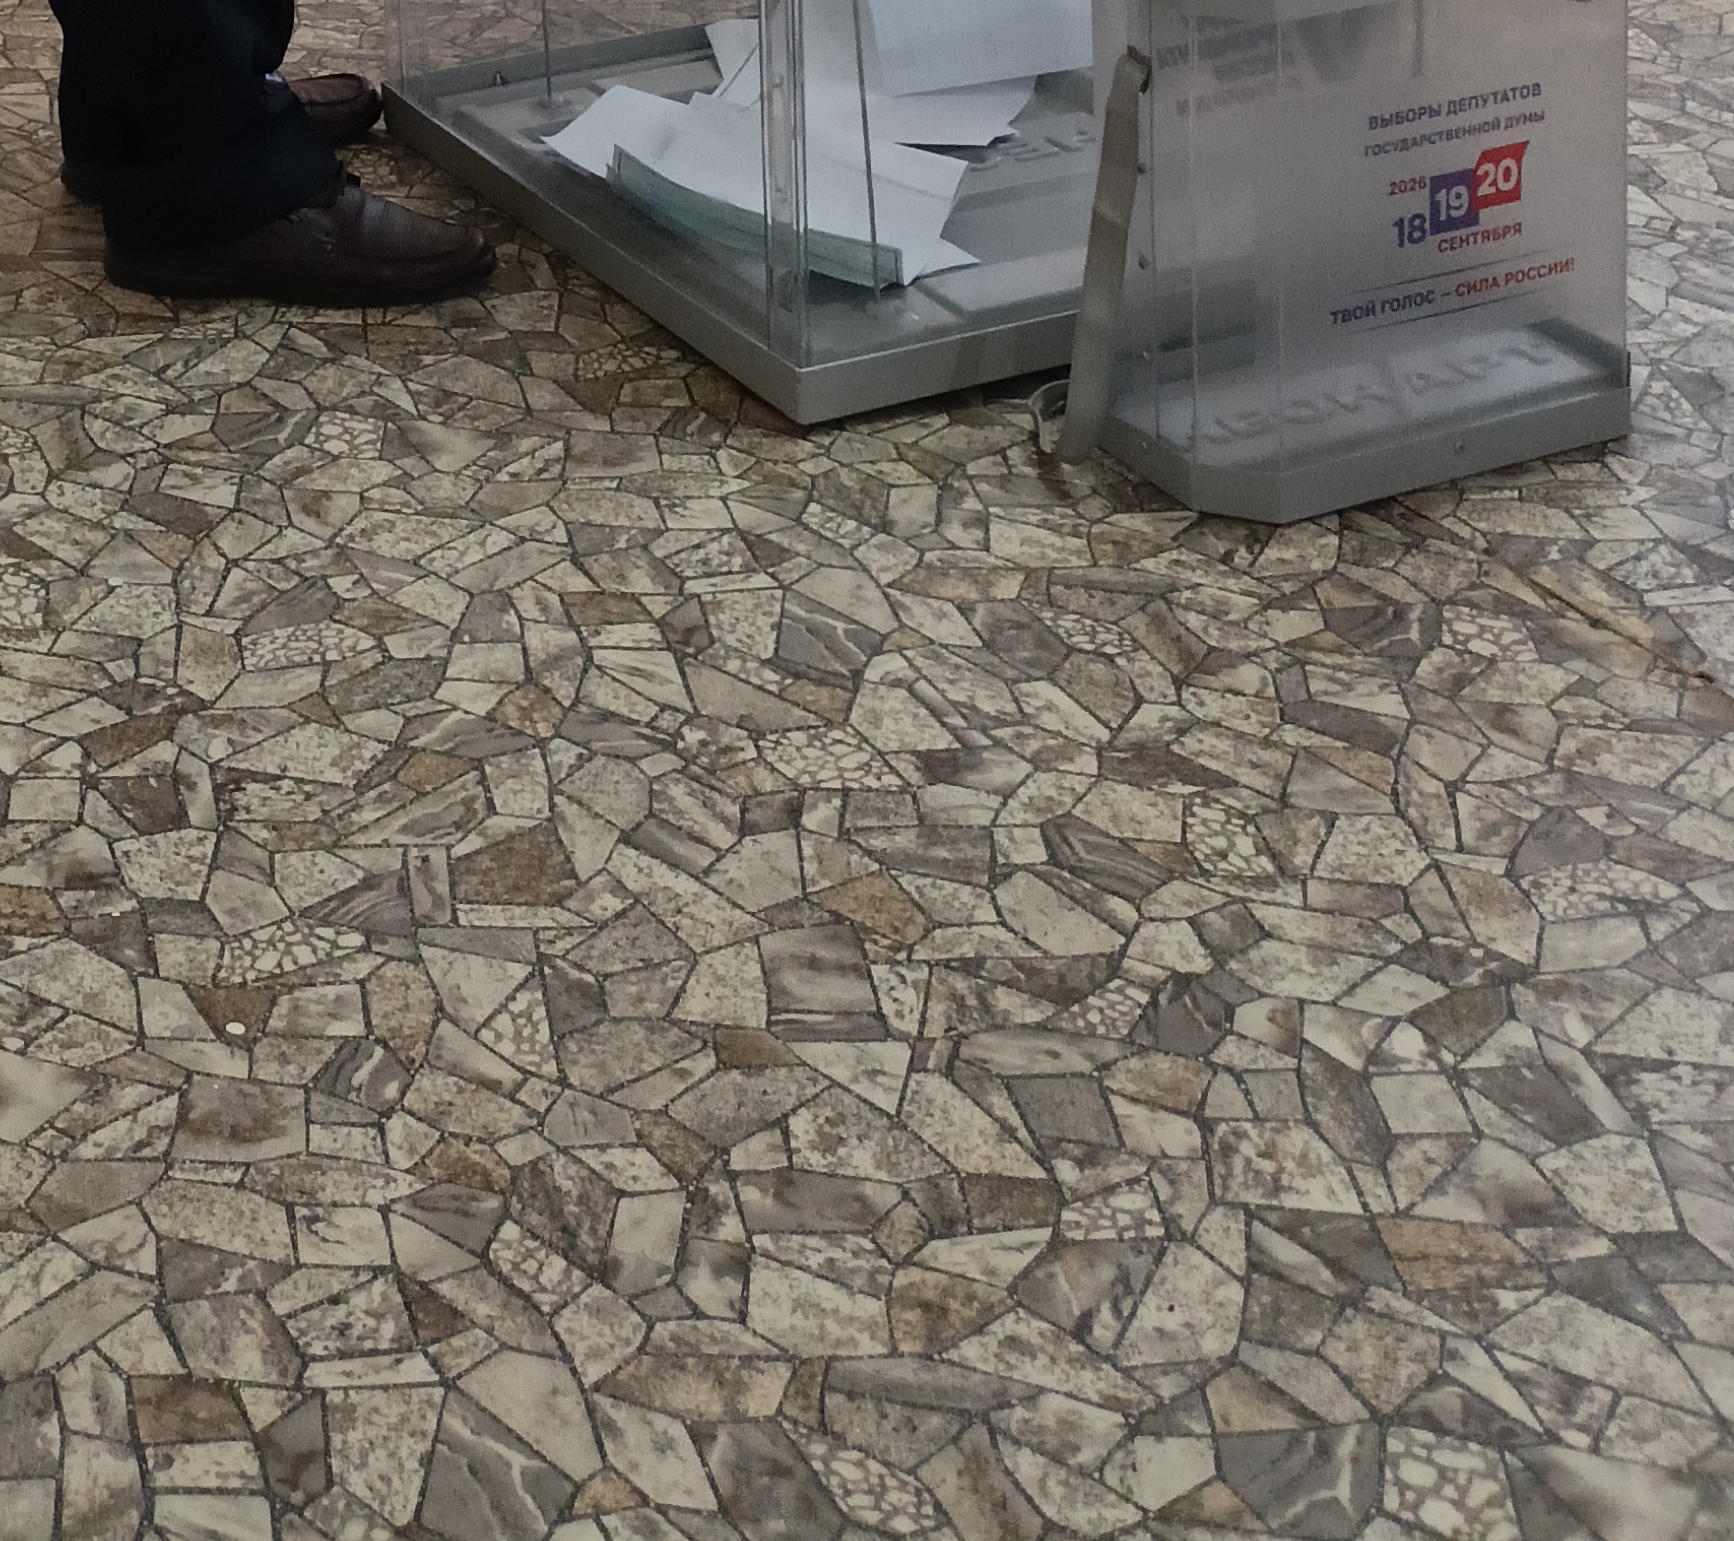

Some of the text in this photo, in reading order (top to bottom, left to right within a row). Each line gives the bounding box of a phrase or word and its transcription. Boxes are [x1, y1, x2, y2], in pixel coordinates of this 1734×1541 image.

[1368, 82, 1542, 132] ВЫБОРЫ ДЕПУТАТОВ
[1364, 109, 1546, 158] ГОСУДАРСТВЕННОЙ ДУМЫ
[1388, 176, 1427, 197] 2026
[1392, 157, 1519, 248] 18 19 20
[1438, 222, 1522, 253] СЕНТЯБРЯ
[1330, 302, 1376, 325] ТВОЙ
[1380, 289, 1436, 313] ГОЛОС
[1454, 276, 1500, 298] СИЛА
[1504, 257, 1575, 286] РОССИИ!
